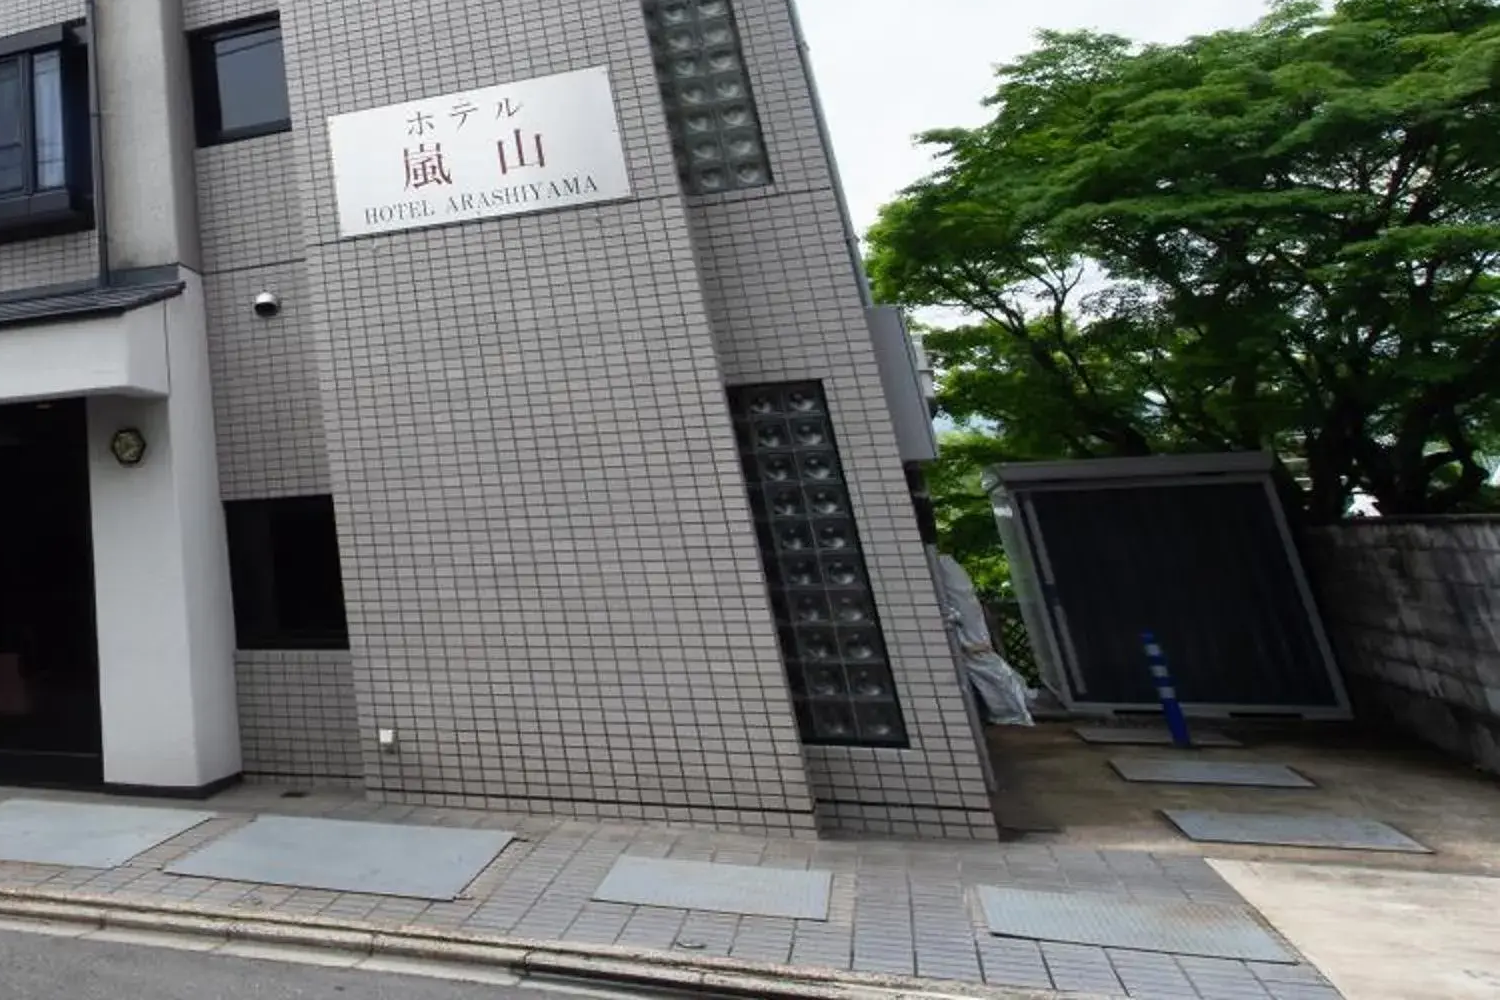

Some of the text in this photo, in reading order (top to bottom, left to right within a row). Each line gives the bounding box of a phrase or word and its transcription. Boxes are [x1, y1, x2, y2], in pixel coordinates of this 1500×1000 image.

[407, 97, 521, 136] ホテル
[364, 175, 598, 225] HOTEL ARASHIYAMA
